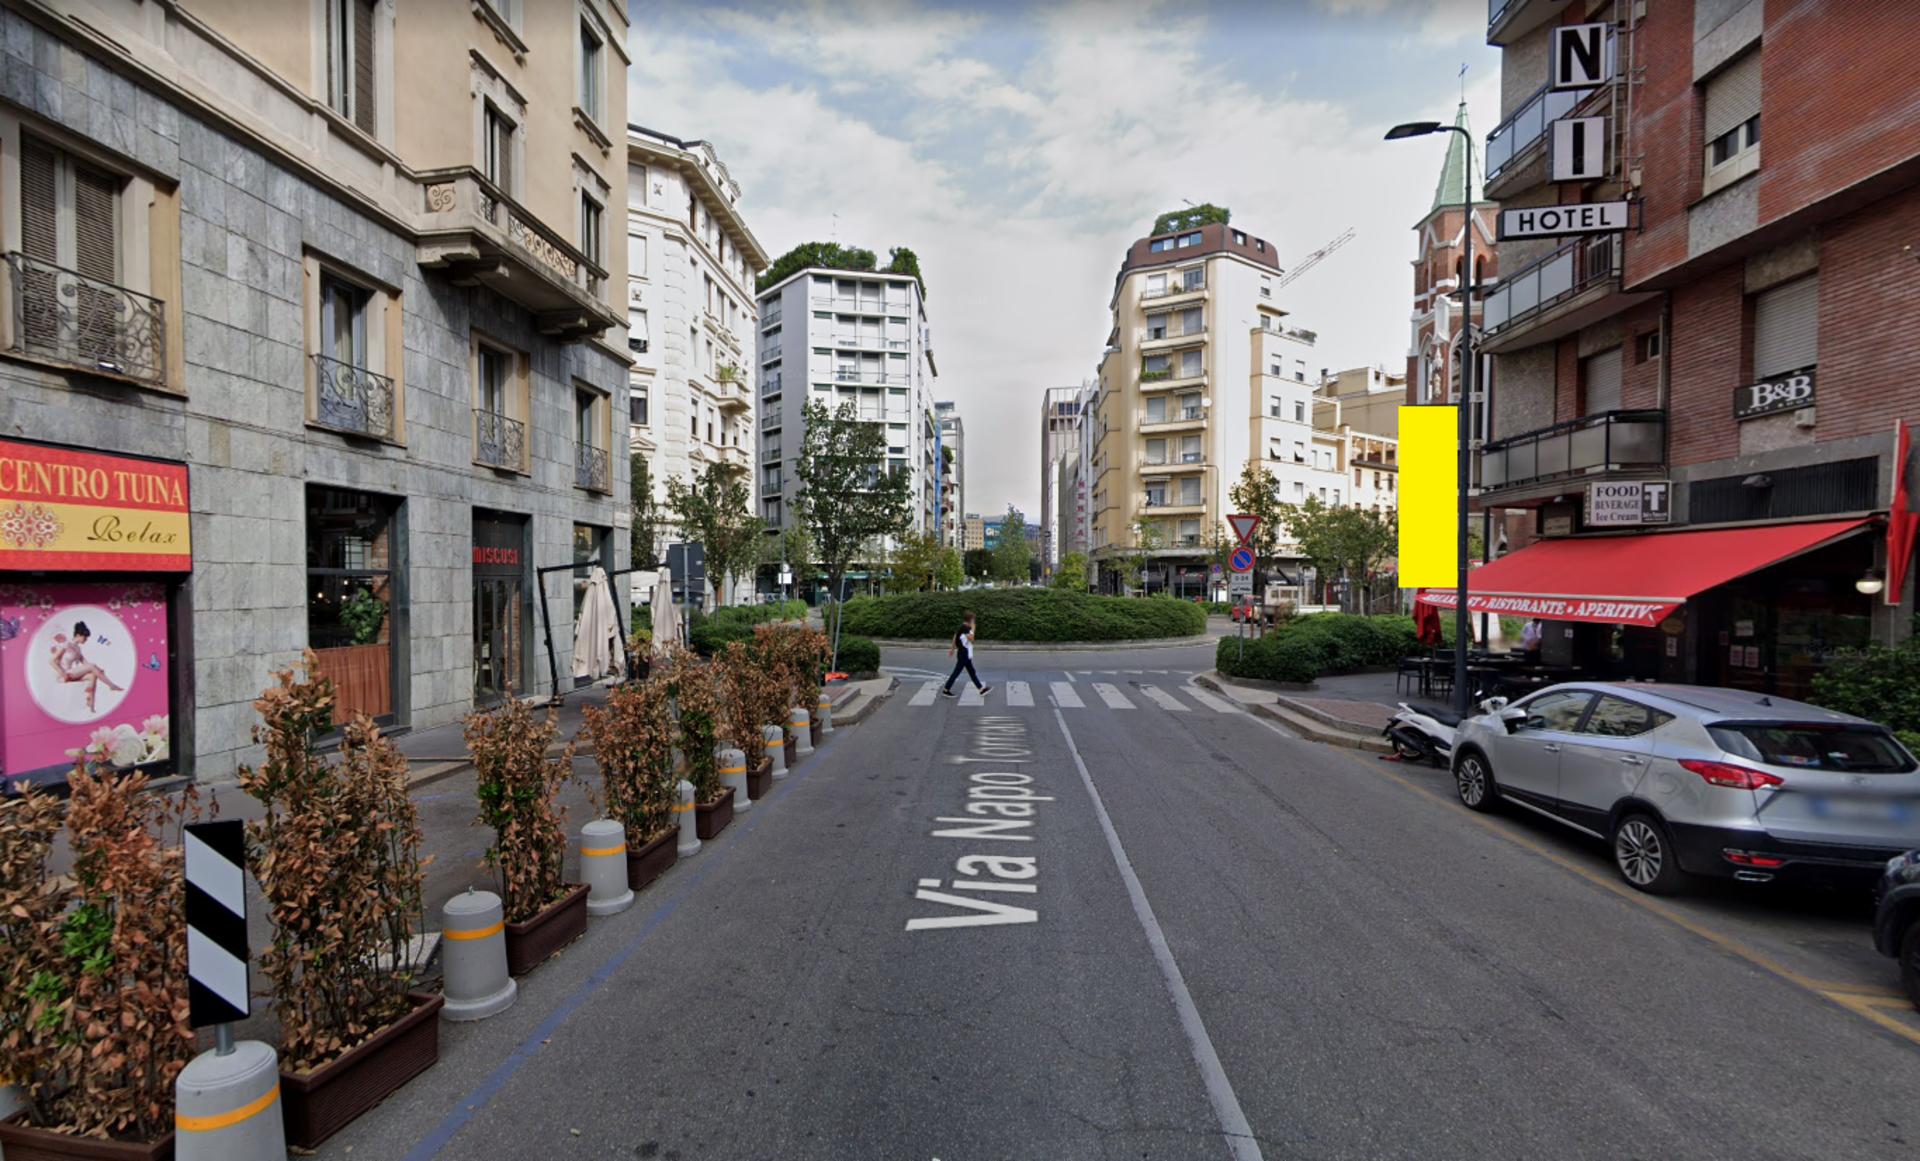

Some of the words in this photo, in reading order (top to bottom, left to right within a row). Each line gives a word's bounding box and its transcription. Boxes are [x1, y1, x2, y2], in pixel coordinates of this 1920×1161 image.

[1519, 206, 1611, 232] HOTEL
[1749, 374, 1812, 409] B&B
[0, 457, 109, 500] CENTRO
[113, 471, 185, 506] TUINA
[1596, 485, 1640, 497] FOOD
[1594, 499, 1641, 510] BEVERAGE
[1644, 484, 1666, 511] T
[86, 515, 177, 544] Relax
[1595, 512, 1608, 522] Ice
[1610, 511, 1639, 522] Cream
[1486, 597, 1566, 616] RISTORANTE
